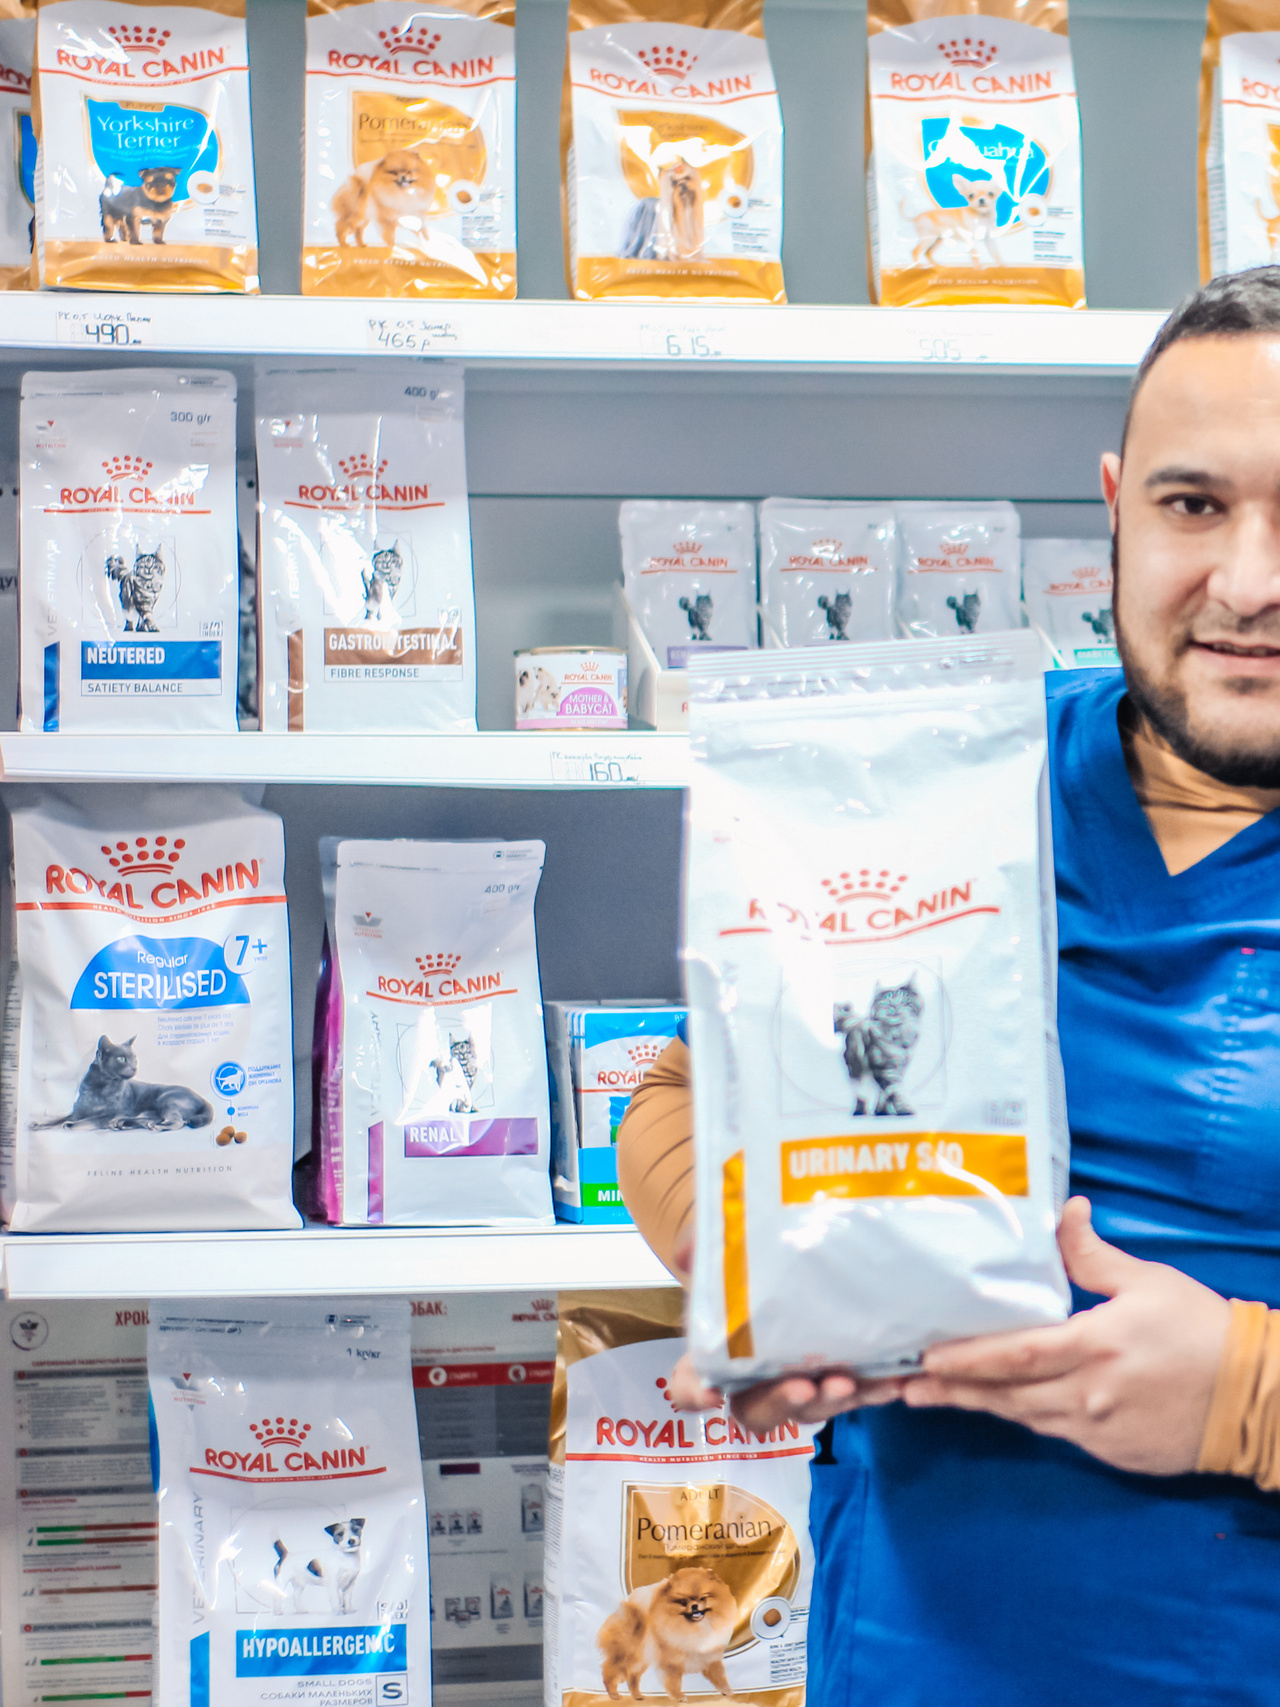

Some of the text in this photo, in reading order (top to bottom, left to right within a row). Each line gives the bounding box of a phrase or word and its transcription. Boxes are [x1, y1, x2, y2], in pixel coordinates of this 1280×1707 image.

[57, 46, 225, 78] ROYAL CANIN
[328, 50, 494, 79] ROYAL CANIN
[590, 68, 752, 98] ROYAL CANIN
[890, 71, 1051, 94] ROYAL CANIN
[97, 115, 194, 132] Yorkshire
[116, 132, 182, 149] Terrier
[927, 140, 1034, 158] Cuahua
[404, 386, 427, 398] 400
[170, 411, 212, 425] 300 g/r
[60, 486, 124, 505] ROYAL
[366, 484, 429, 501] CANIN
[918, 556, 953, 568] ROYAL
[87, 647, 165, 665] NEUTERED
[330, 668, 419, 678] FIBRE RESPONSE
[87, 683, 183, 693] SATIETY BALANCE
[569, 694, 602, 704] MOTHER
[565, 703, 614, 715] BABYCAT
[46, 858, 260, 910] ROYAL CANIN
[485, 884, 505, 895] 400
[866, 880, 973, 932] CANIN
[137, 950, 188, 968] Regular
[235, 935, 268, 966] 7+
[93, 969, 227, 1000] STERILISED
[378, 972, 500, 998] ROYAL CANIN
[409, 1126, 458, 1143] RENAL
[789, 1140, 966, 1180] URINARY S/O
[87, 1165, 233, 1177] FELINE HEALTH NUTRITION
[410, 1300, 448, 1317] ОБАК:
[597, 1416, 694, 1448] ROYAL
[205, 1446, 366, 1473] ROYAL CANIN
[680, 1488, 720, 1501] ADULT
[637, 1514, 772, 1542] Pomeranian
[242, 1633, 396, 1658] HYPOALLERGENIC
[297, 1678, 373, 1688] SMALL DOGS
[382, 1681, 403, 1699] S
[260, 1689, 373, 1701] СОБАКИ МАЛЕНЬКИХ
